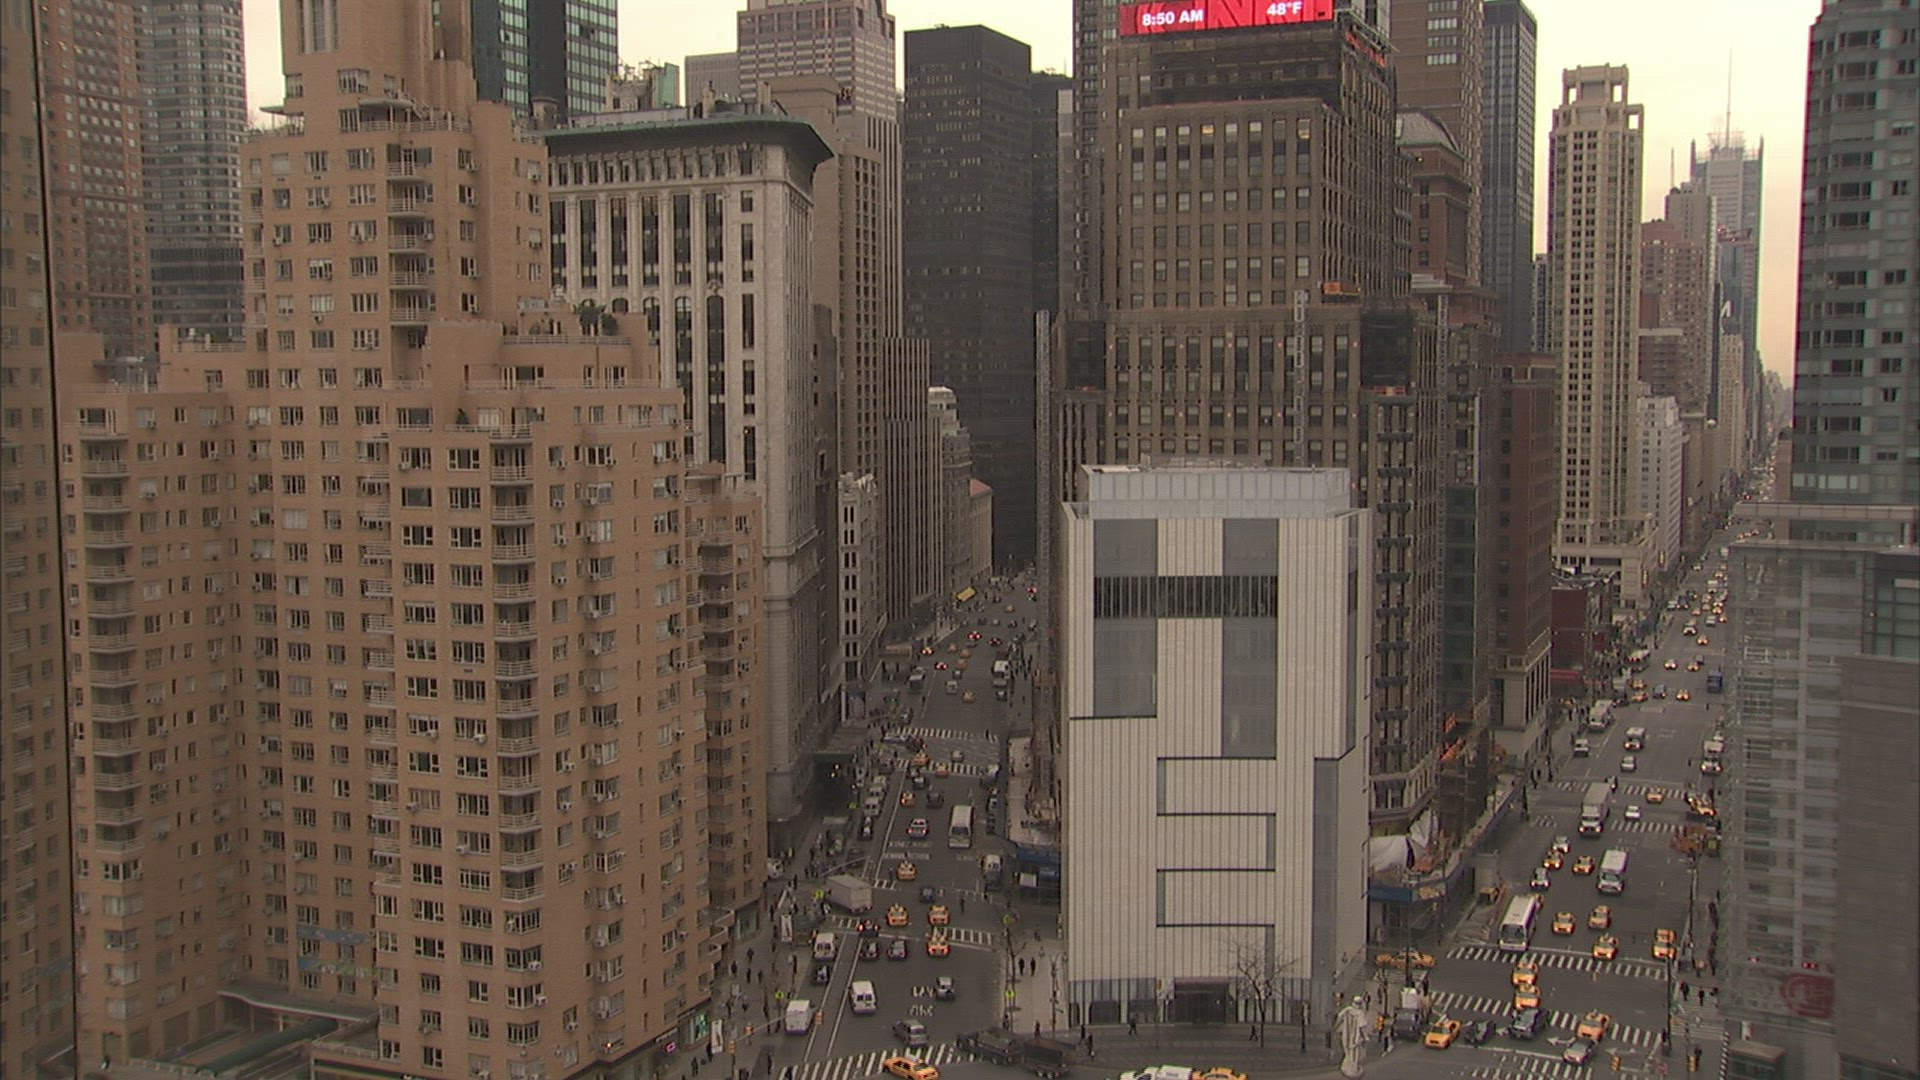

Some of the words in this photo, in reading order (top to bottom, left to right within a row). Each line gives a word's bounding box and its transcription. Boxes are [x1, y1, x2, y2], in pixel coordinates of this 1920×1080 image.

[1267, 1, 1302, 16] 48°F
[1142, 14, 1175, 26] 8:50
[1179, 10, 1204, 23] AM
